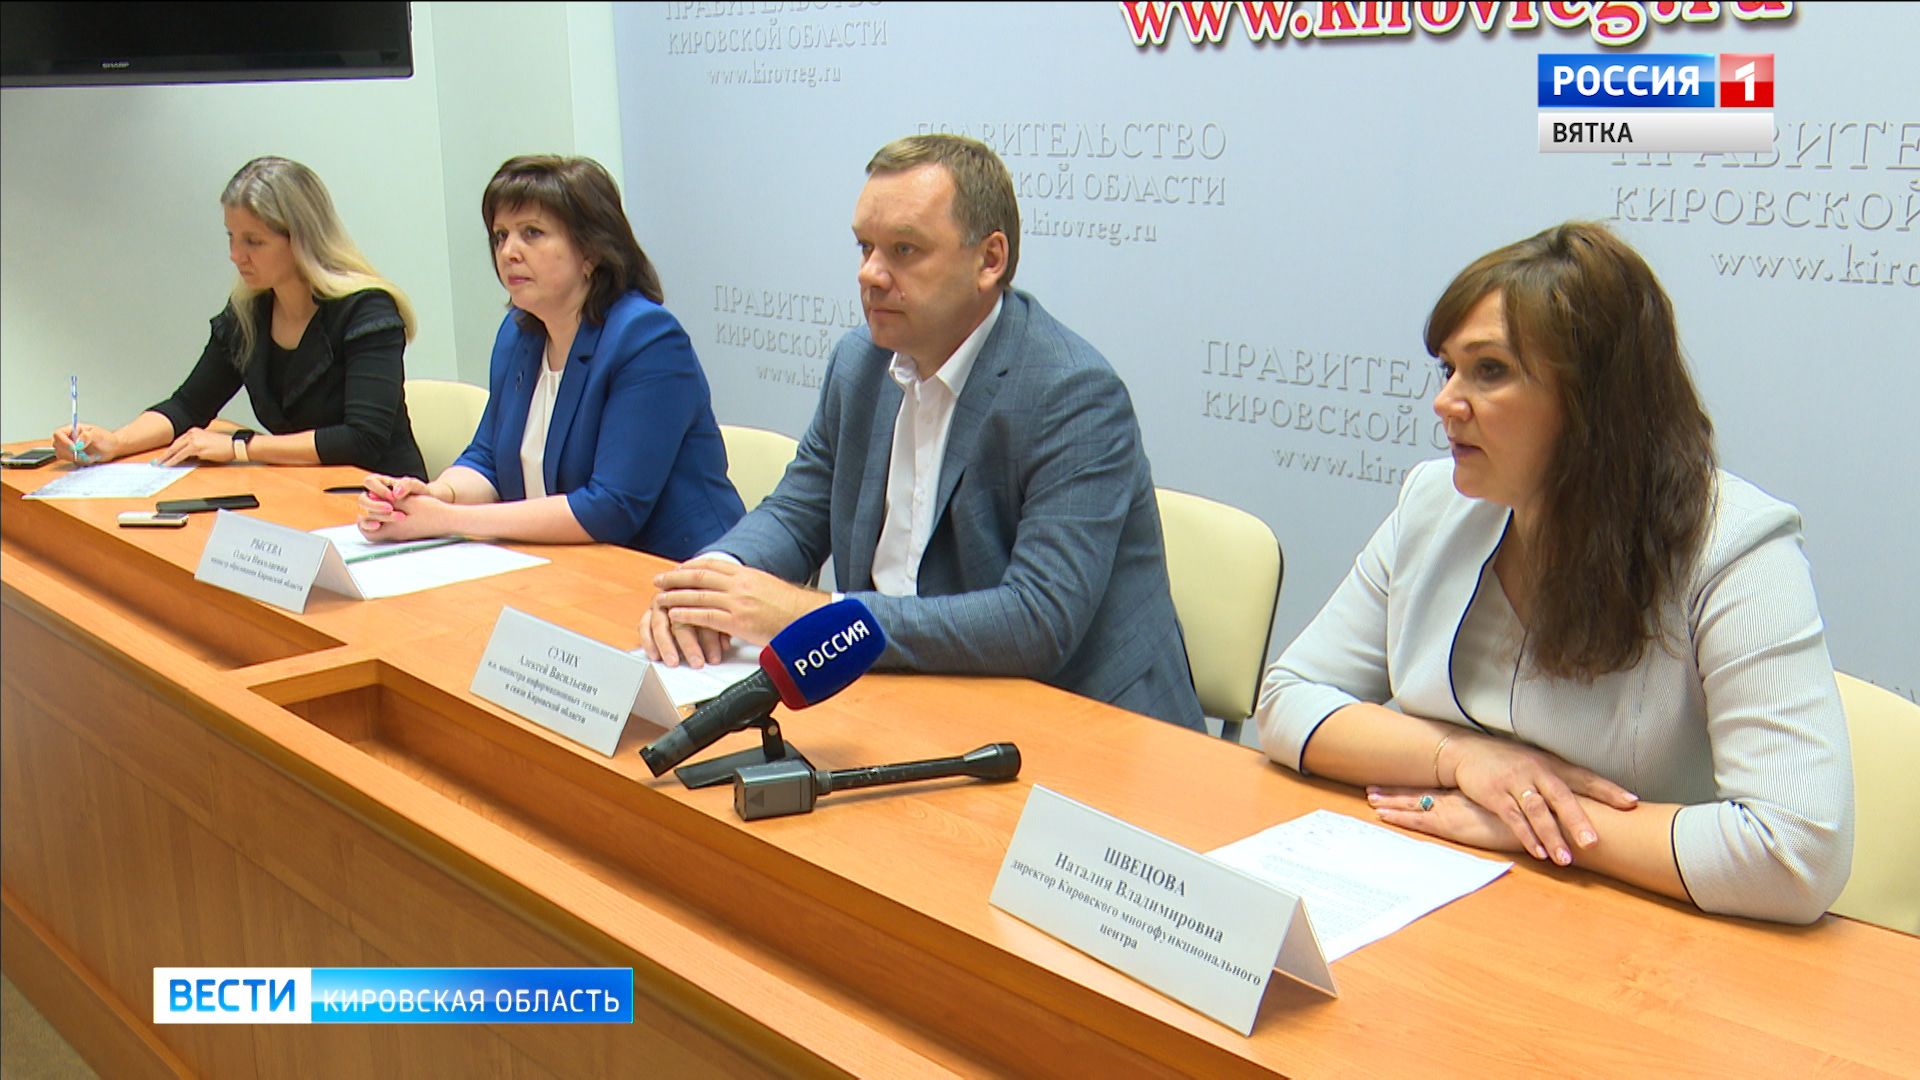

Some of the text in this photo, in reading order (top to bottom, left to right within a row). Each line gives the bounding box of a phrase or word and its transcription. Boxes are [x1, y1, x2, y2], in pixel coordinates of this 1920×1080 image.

[667, 19, 888, 55] КИРОВСКОЙ ОБЛАСТИ
[709, 60, 842, 88] www.kirovreg.ru
[1085, 173, 1226, 206] ОБЛАСТИ
[1202, 390, 1417, 446] КИРОВСКОЙ
[794, 619, 871, 677] РОССИЯ
[549, 665, 599, 696] Васильевич
[1104, 847, 1187, 897] ШВЕЦОВА
[1054, 852, 1224, 944] Наталия Владимировна
[1010, 858, 1262, 986] директор Кировского многофункционального
[1099, 922, 1139, 949] центра
